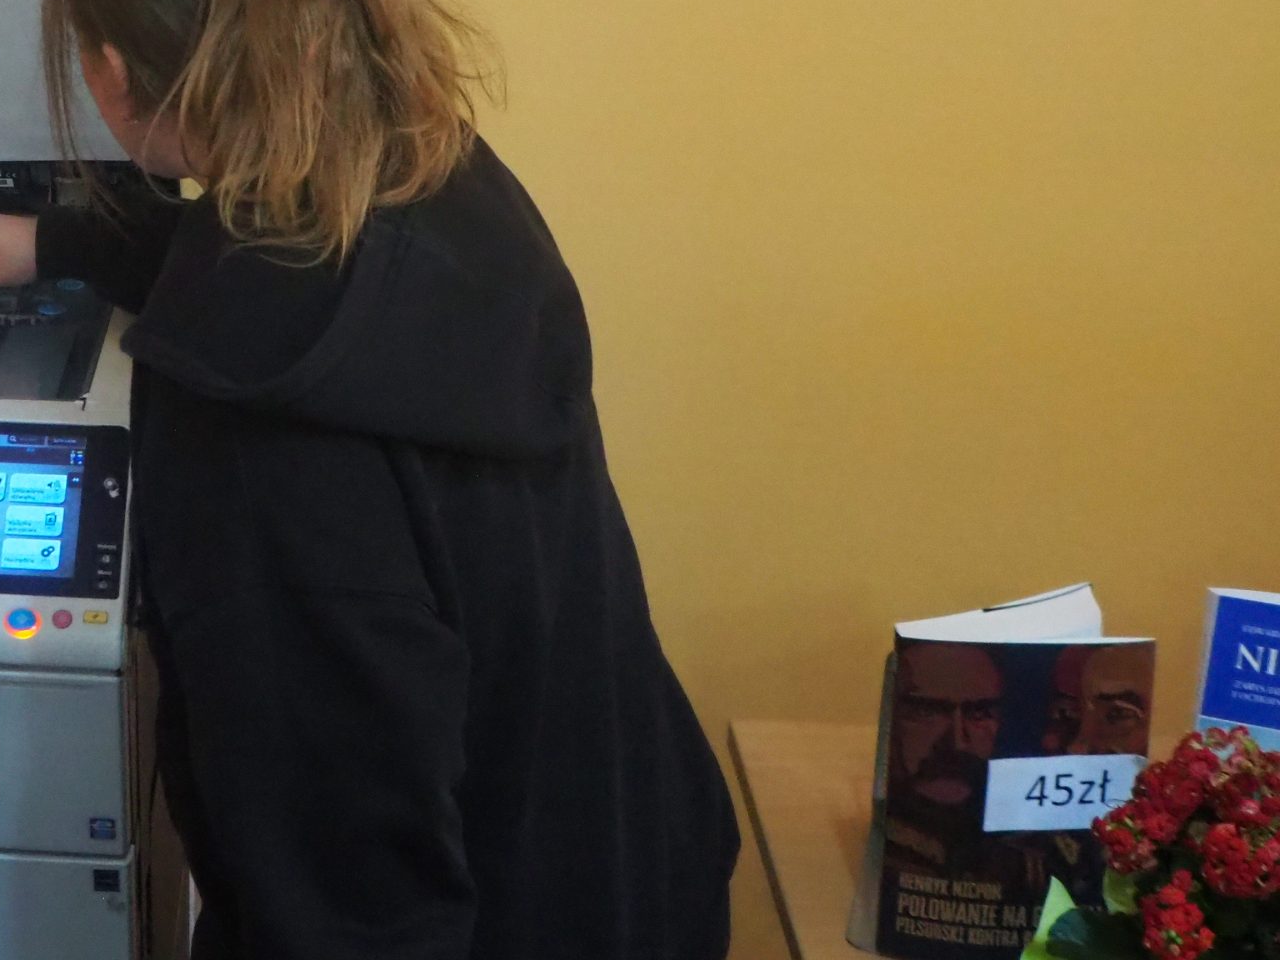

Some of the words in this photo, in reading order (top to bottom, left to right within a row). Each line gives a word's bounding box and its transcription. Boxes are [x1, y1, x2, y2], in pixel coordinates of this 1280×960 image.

[1024, 769, 1111, 807] 45zł
[897, 892, 999, 927] POLOWANIE
[1002, 904, 1028, 928] NA
